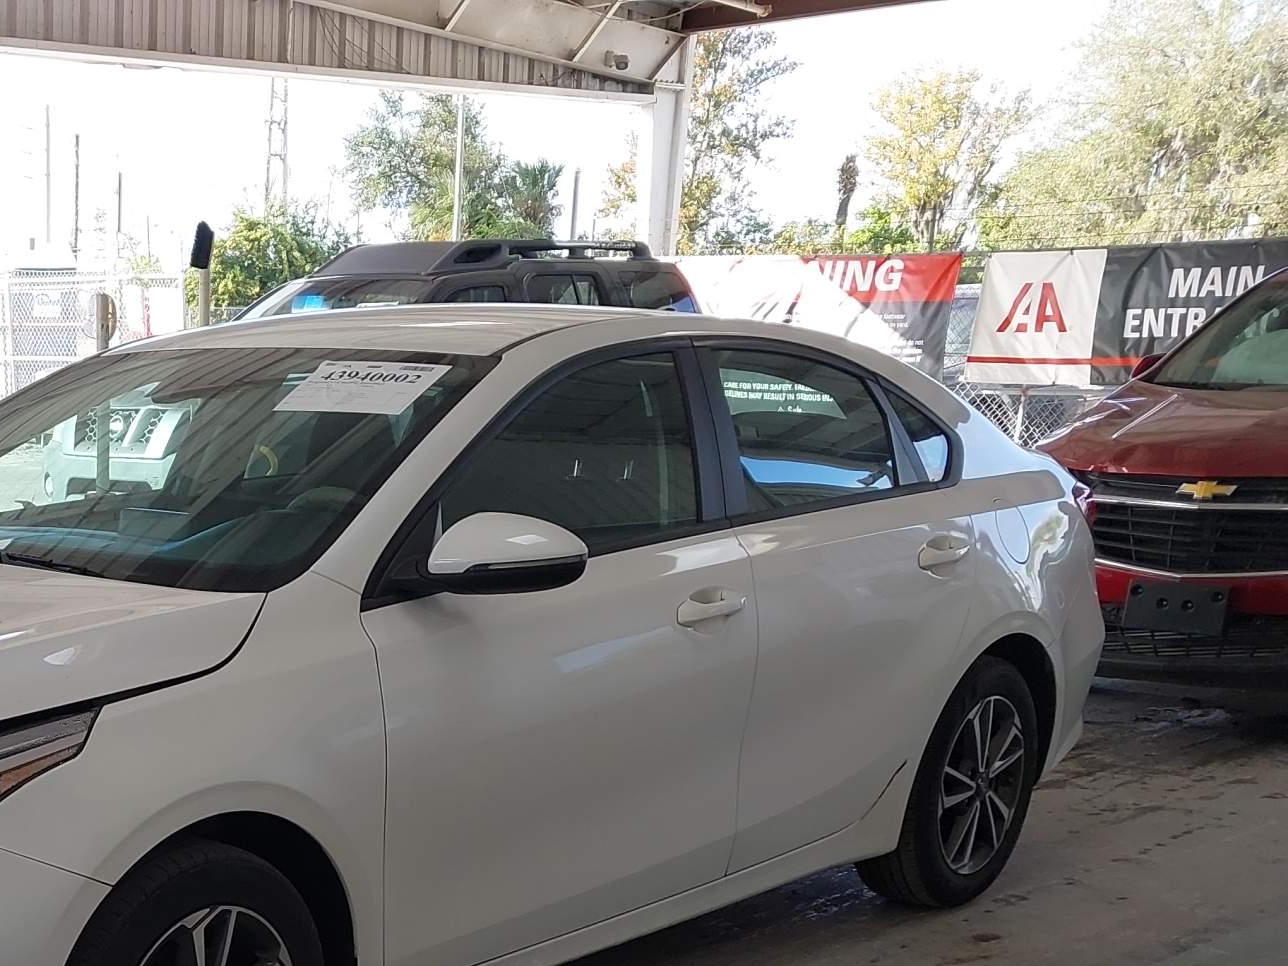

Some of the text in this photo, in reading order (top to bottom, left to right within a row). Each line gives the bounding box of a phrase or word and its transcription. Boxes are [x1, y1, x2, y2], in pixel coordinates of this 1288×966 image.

[1168, 264, 1265, 298] MAIN
[321, 370, 422, 384] 43940002
[752, 382, 769, 390] YOUR
[795, 392, 821, 402] SERIOUS
